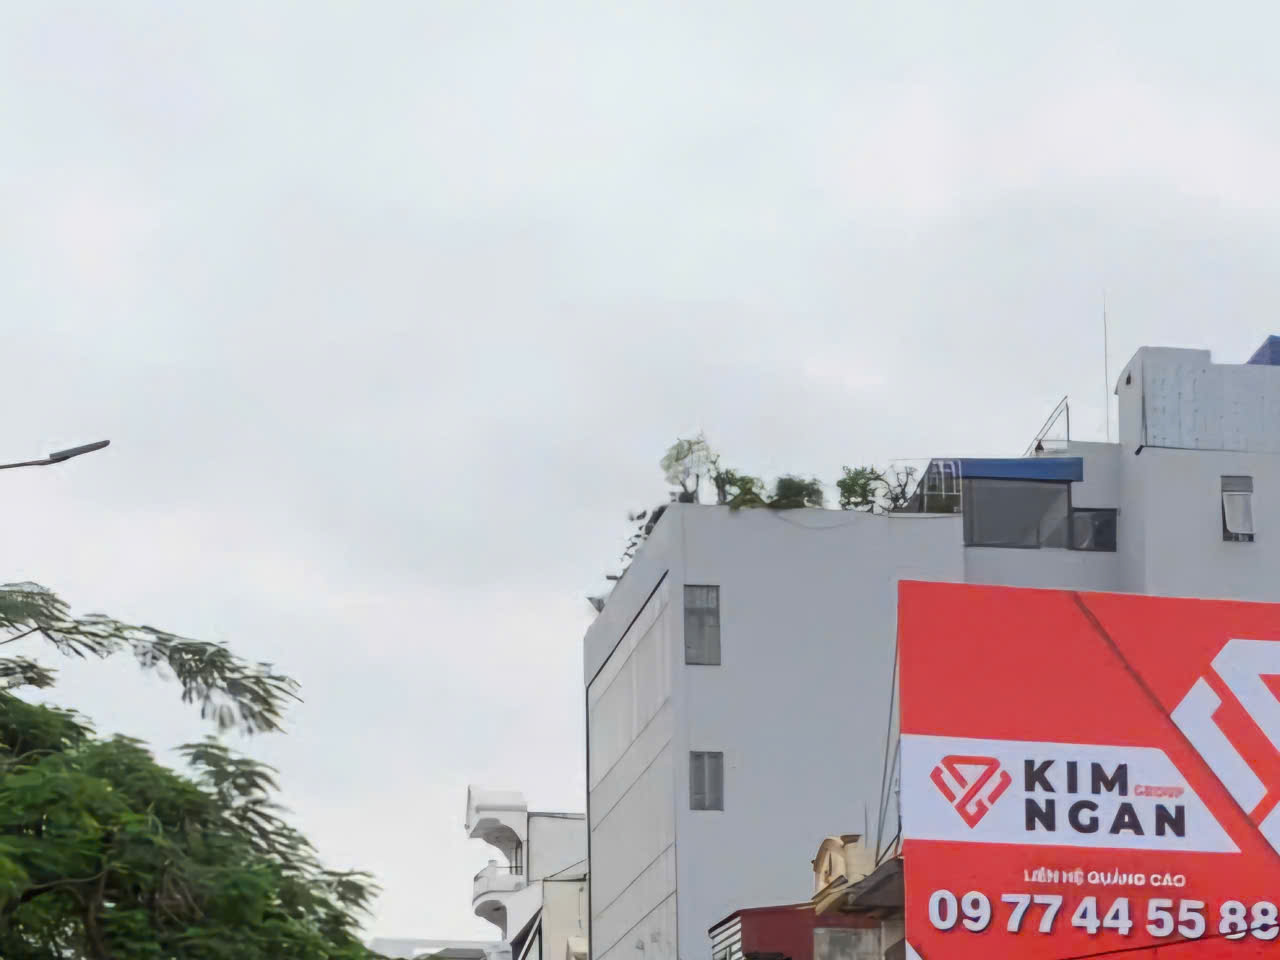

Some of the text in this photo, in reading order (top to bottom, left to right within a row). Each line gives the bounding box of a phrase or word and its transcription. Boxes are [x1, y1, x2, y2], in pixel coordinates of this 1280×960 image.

[1024, 759, 1128, 796] KIM
[1025, 798, 1186, 837] NGAN
[928, 889, 1280, 941] 09 77 44 55 88
